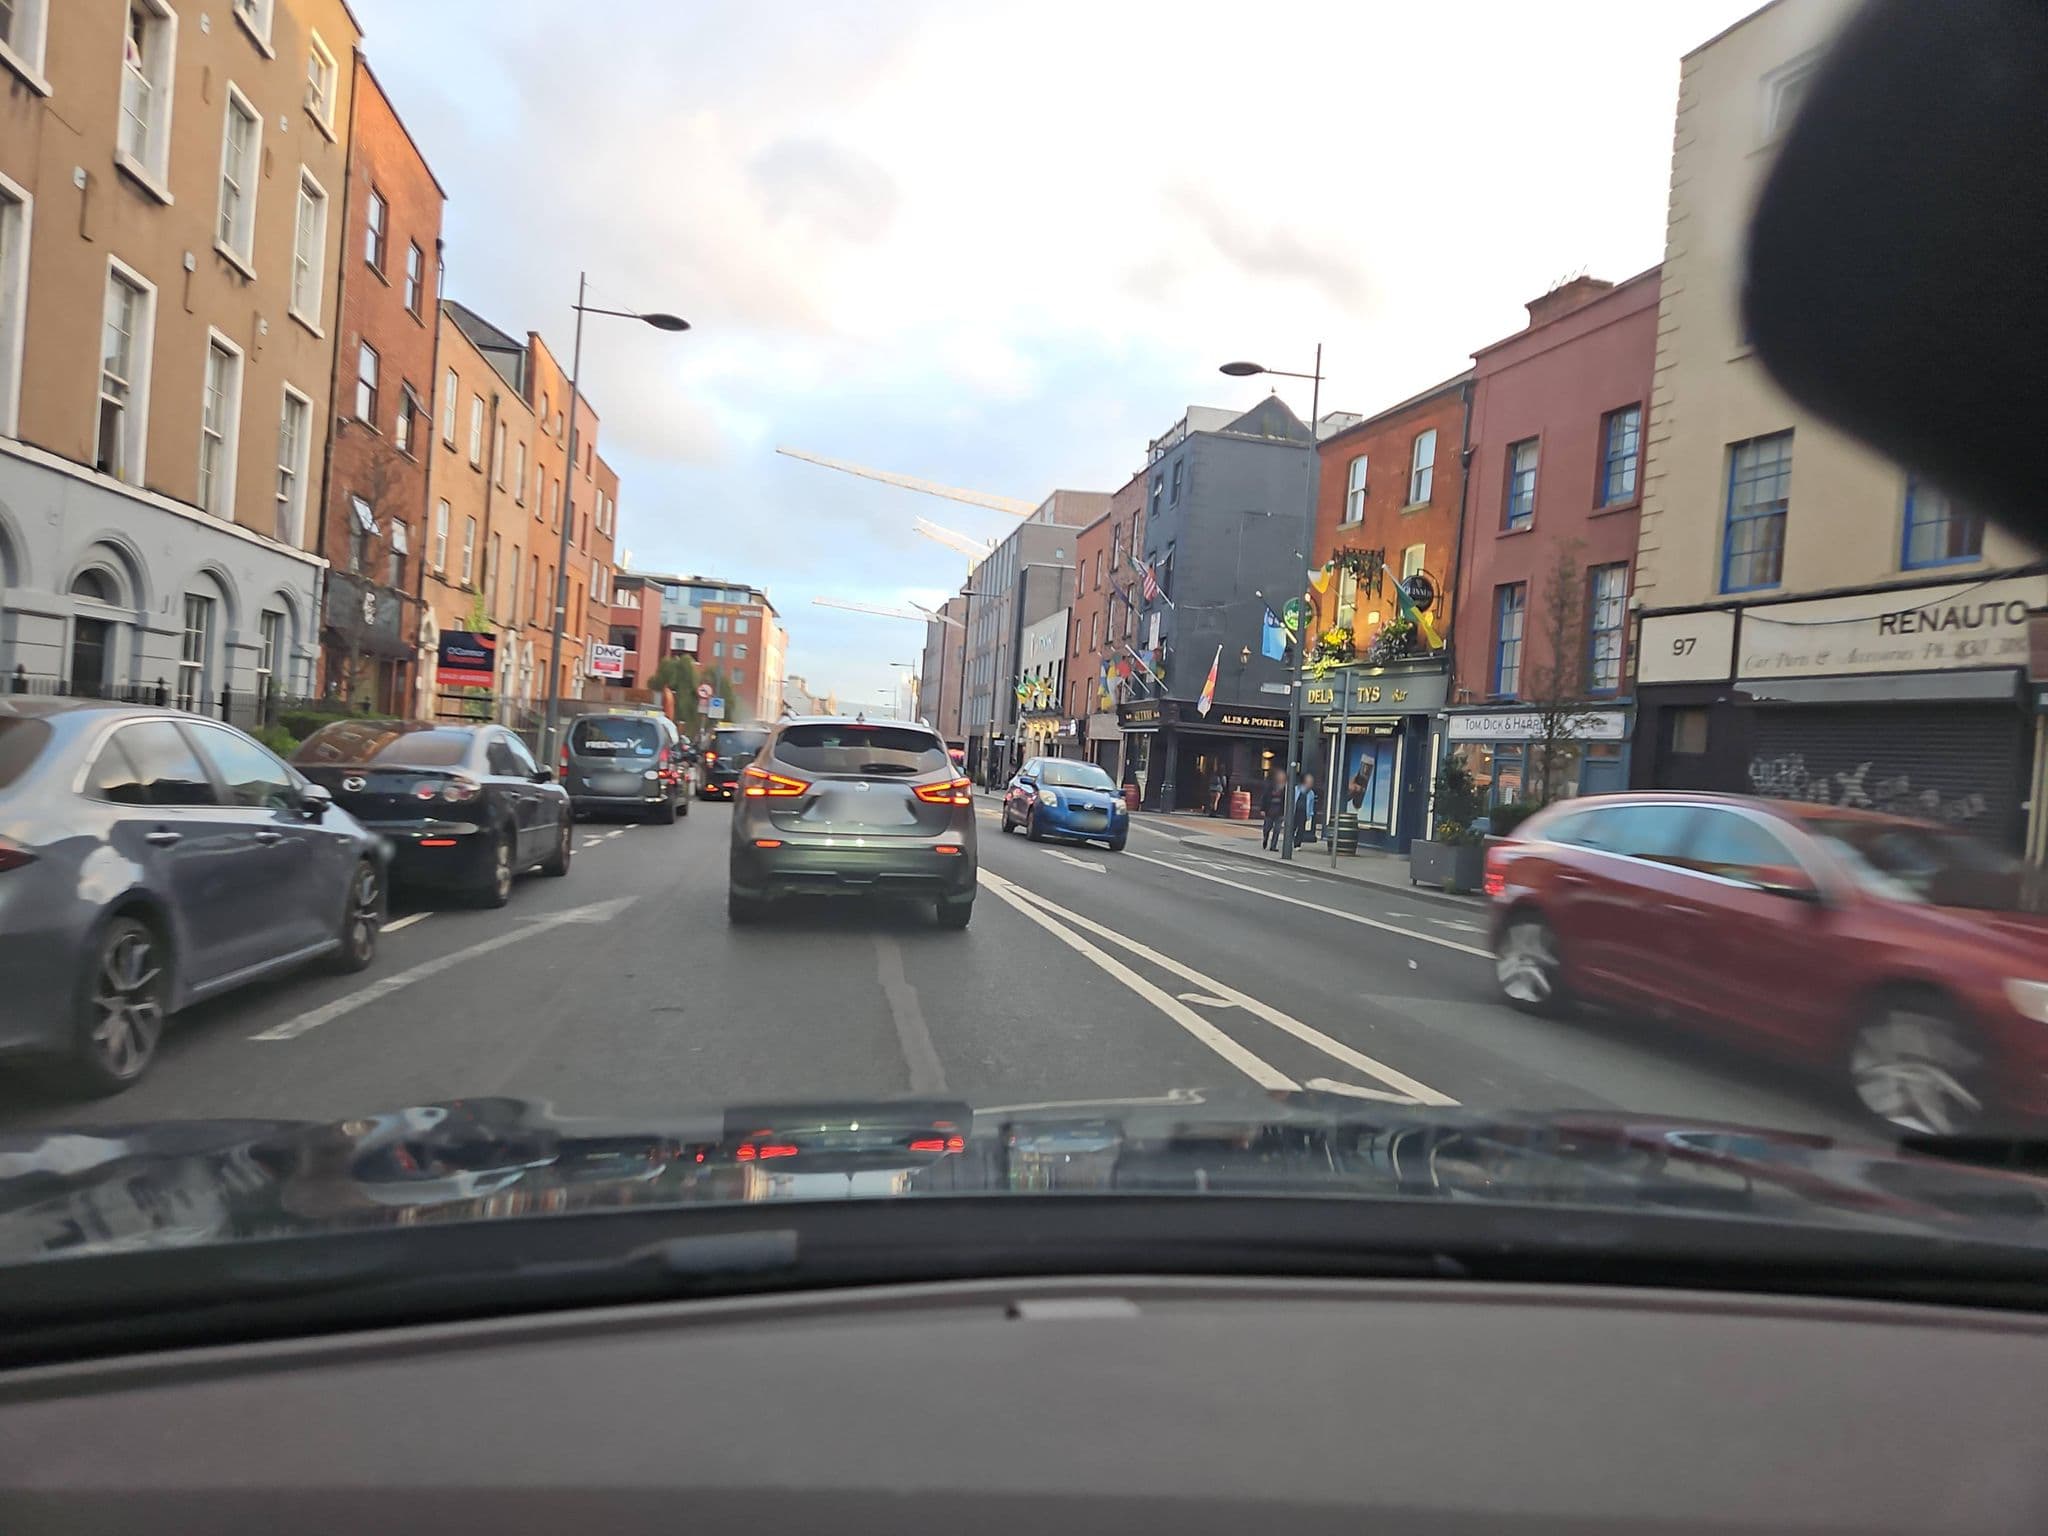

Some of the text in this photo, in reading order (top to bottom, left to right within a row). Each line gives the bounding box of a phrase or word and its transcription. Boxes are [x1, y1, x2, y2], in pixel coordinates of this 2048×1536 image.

[1878, 600, 2029, 636] RENAUTO
[595, 645, 622, 658] DNG
[1672, 638, 1697, 656] 97
[1307, 686, 1381, 704] DELATYS
[1221, 715, 1285, 728] ALES & PORTER
[1505, 718, 1511, 730] &
